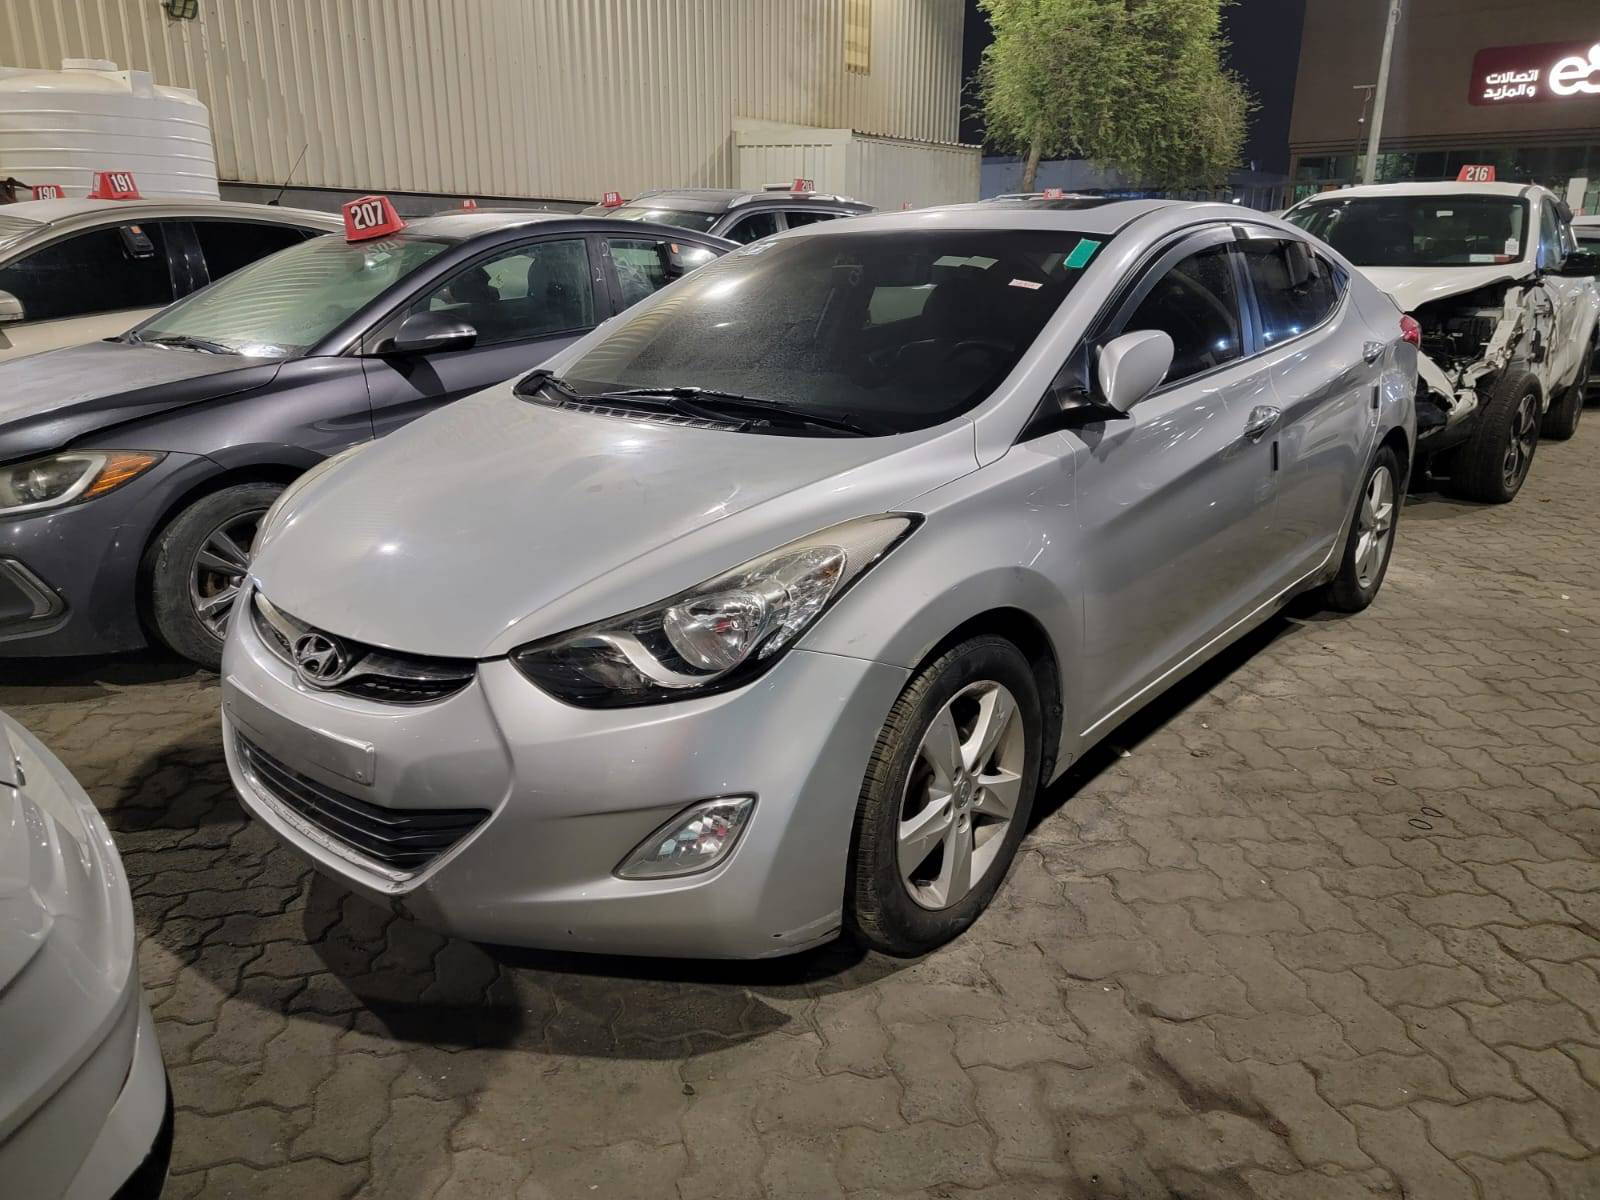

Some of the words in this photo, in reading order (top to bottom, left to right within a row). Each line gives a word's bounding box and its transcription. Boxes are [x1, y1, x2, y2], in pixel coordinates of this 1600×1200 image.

[1486, 69, 1539, 85] اتصالات
[1483, 83, 1536, 100] والمزيد
[1466, 167, 1489, 181] 216
[111, 173, 135, 193] 191
[37, 186, 57, 200] 190
[350, 200, 384, 230] 207
